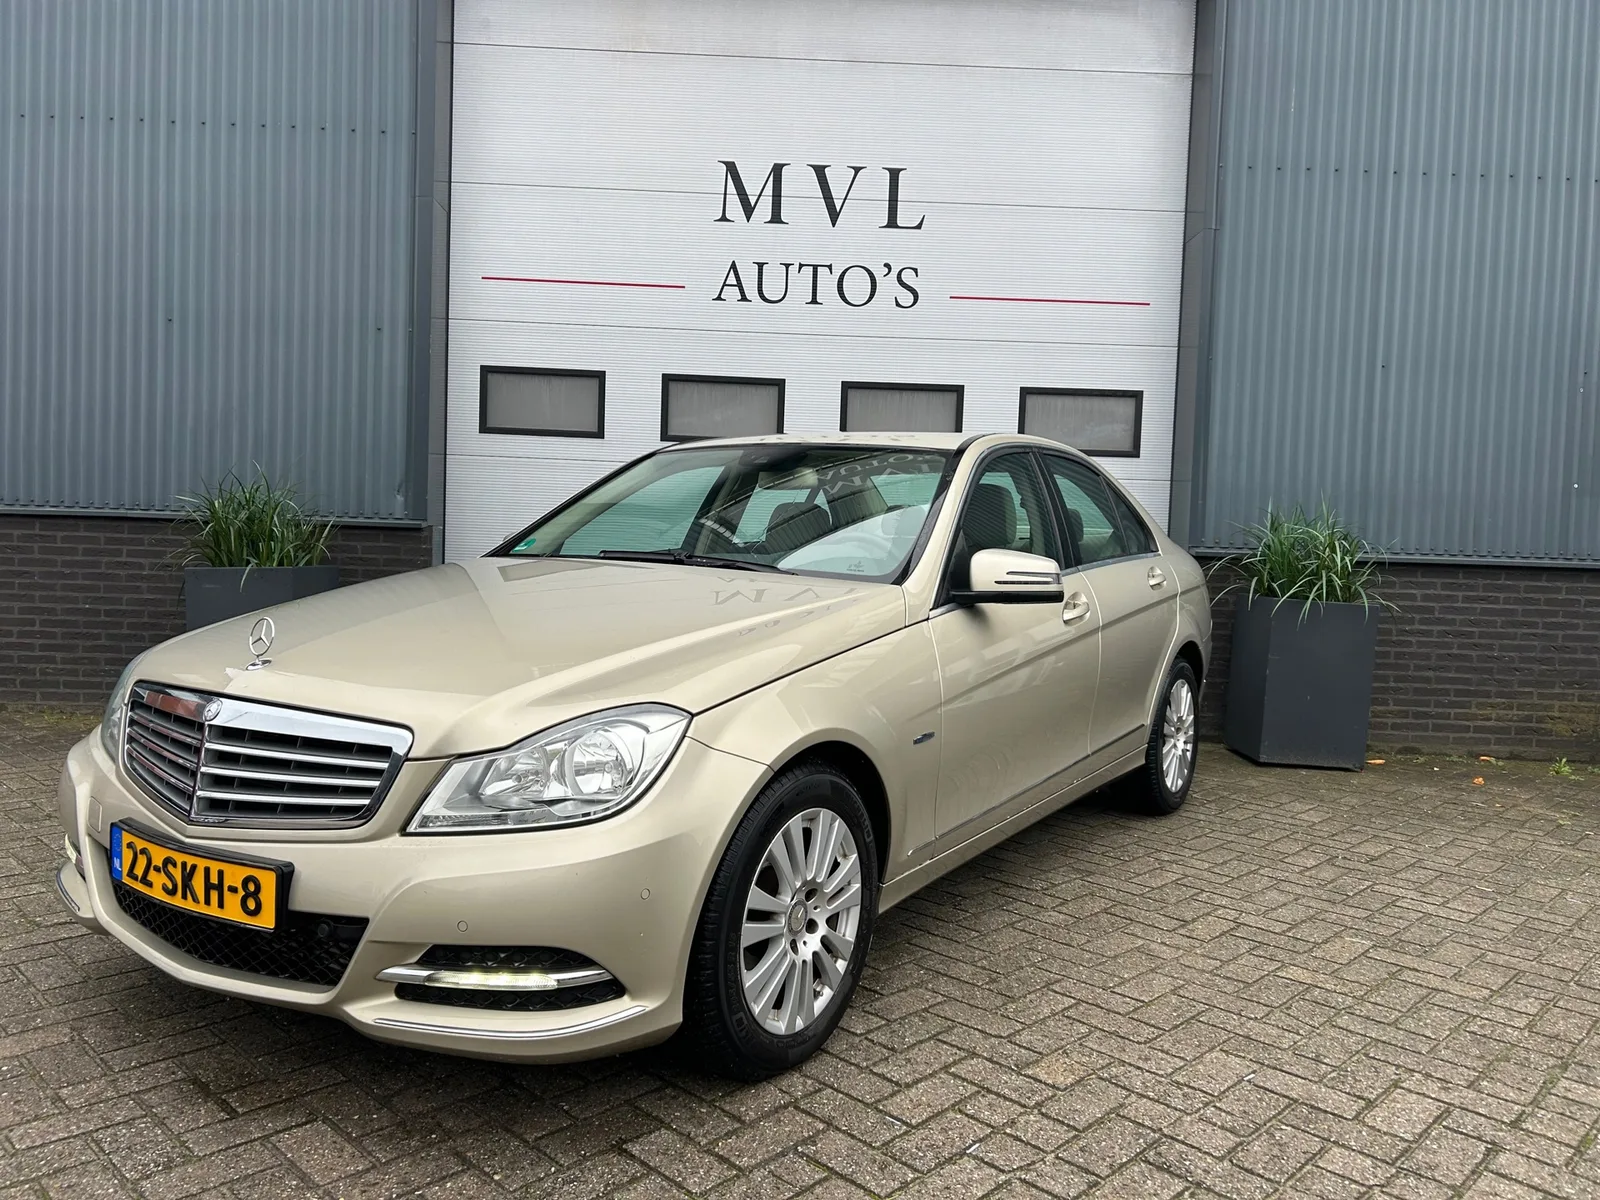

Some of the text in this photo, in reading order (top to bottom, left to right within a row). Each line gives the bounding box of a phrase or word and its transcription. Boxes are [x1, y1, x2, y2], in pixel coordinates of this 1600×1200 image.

[711, 260, 920, 309] AUTO'S
[113, 857, 122, 871] NL
[126, 841, 263, 917] 22-SKH-8
